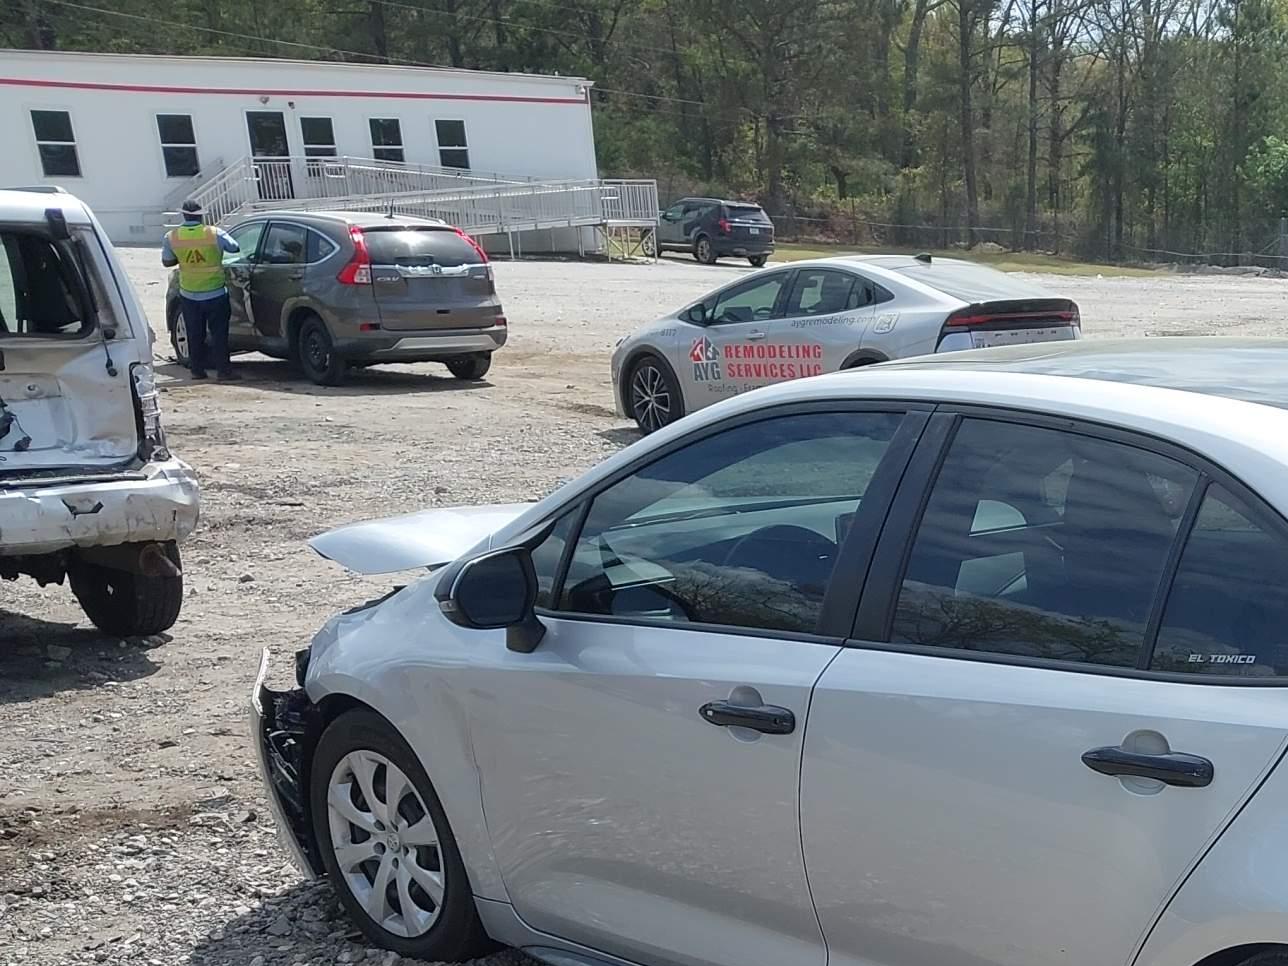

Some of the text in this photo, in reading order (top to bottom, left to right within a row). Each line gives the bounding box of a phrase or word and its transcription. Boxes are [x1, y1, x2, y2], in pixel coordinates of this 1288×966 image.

[724, 344, 822, 359] REMODELING
[694, 362, 721, 381] AYG
[728, 362, 796, 378] SERVICES
[1188, 654, 1256, 664] EL TOXICO
